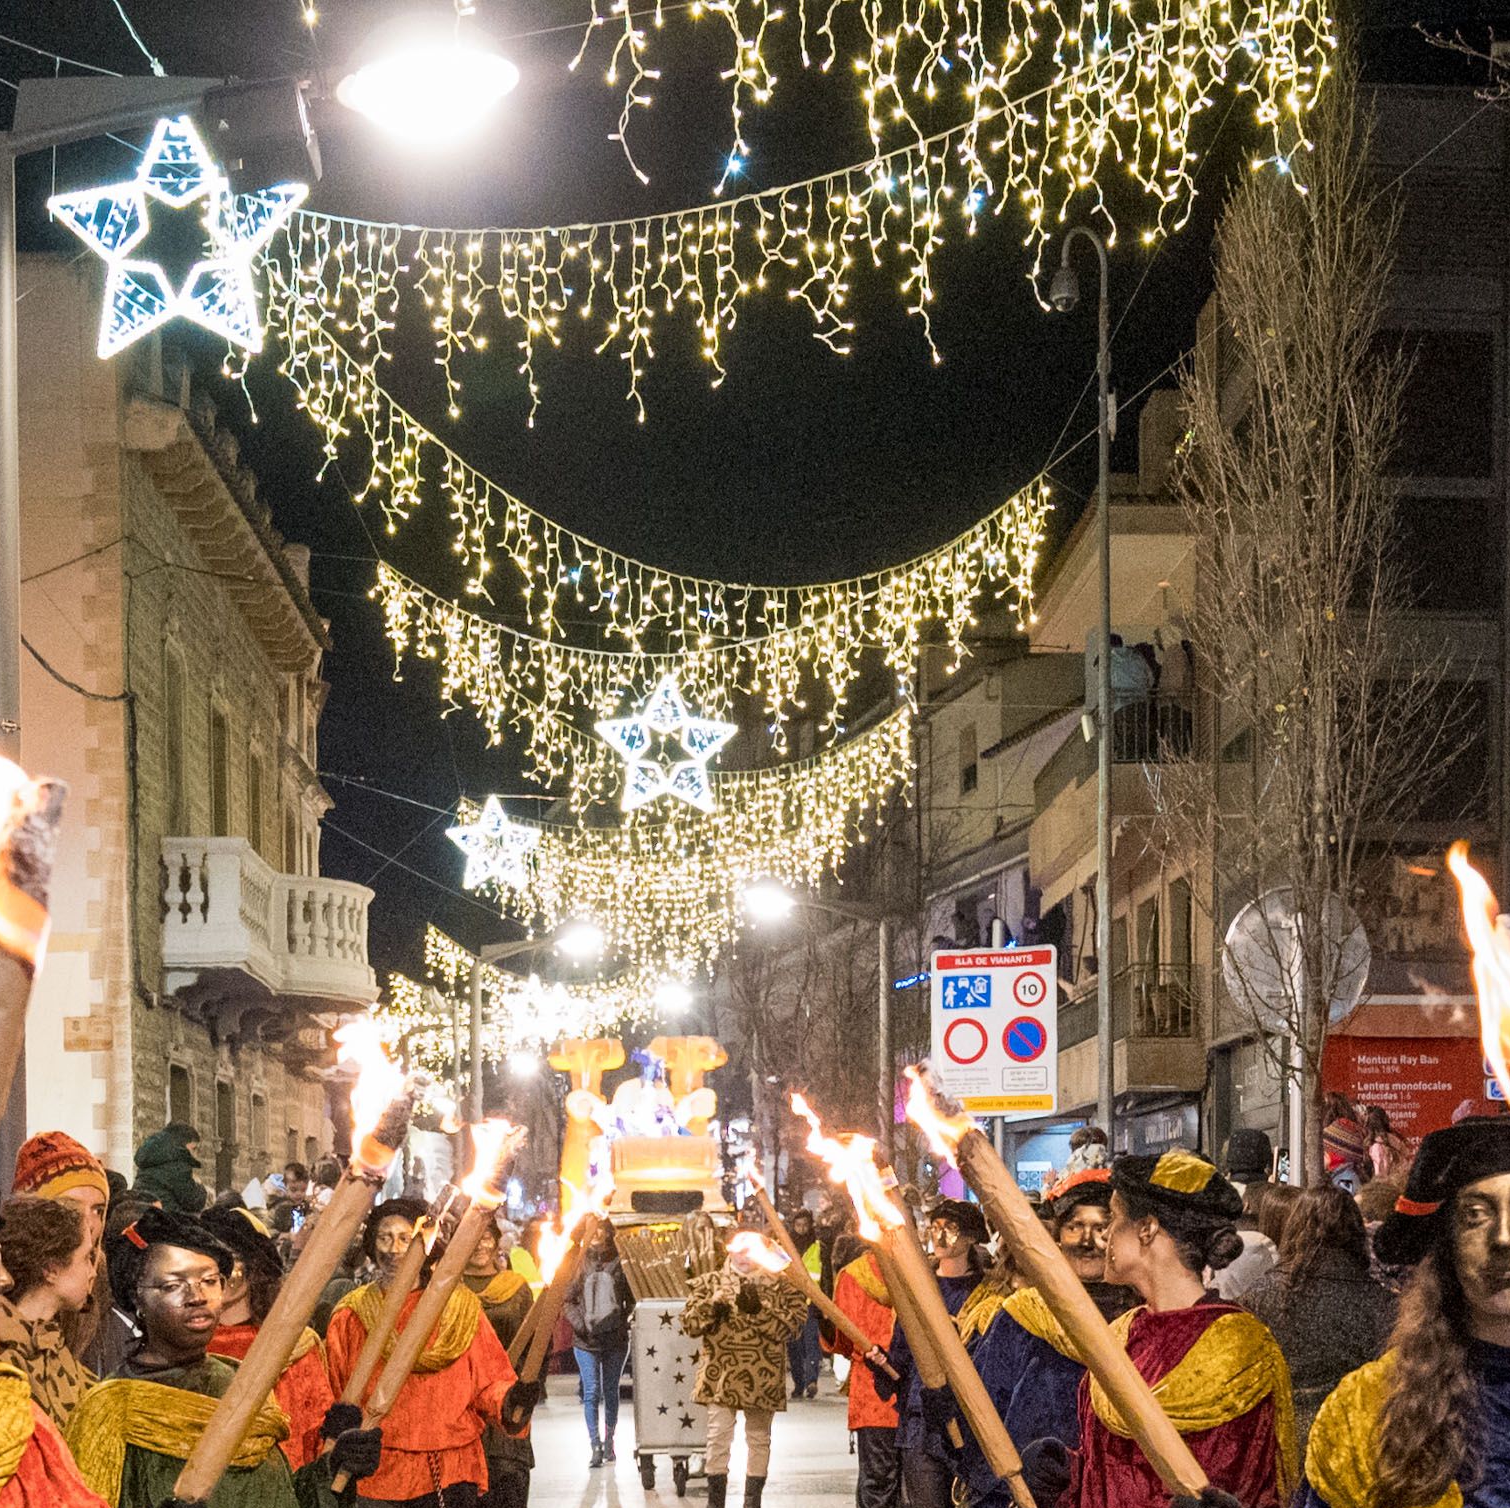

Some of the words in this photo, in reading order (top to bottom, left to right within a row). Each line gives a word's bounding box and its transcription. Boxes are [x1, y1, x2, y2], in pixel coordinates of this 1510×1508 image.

[954, 957, 973, 966] ILLA
[975, 956, 988, 966] DE
[989, 954, 1033, 965] VIANANTS
[1021, 984, 1038, 996] 10
[1357, 1055, 1398, 1065] Montura
[1399, 1055, 1418, 1066] Ray
[1419, 1055, 1439, 1065] Ban
[1357, 1082, 1390, 1091] Lentes
[1391, 1081, 1453, 1091] monofocales
[1357, 1092, 1398, 1101] reducidas
